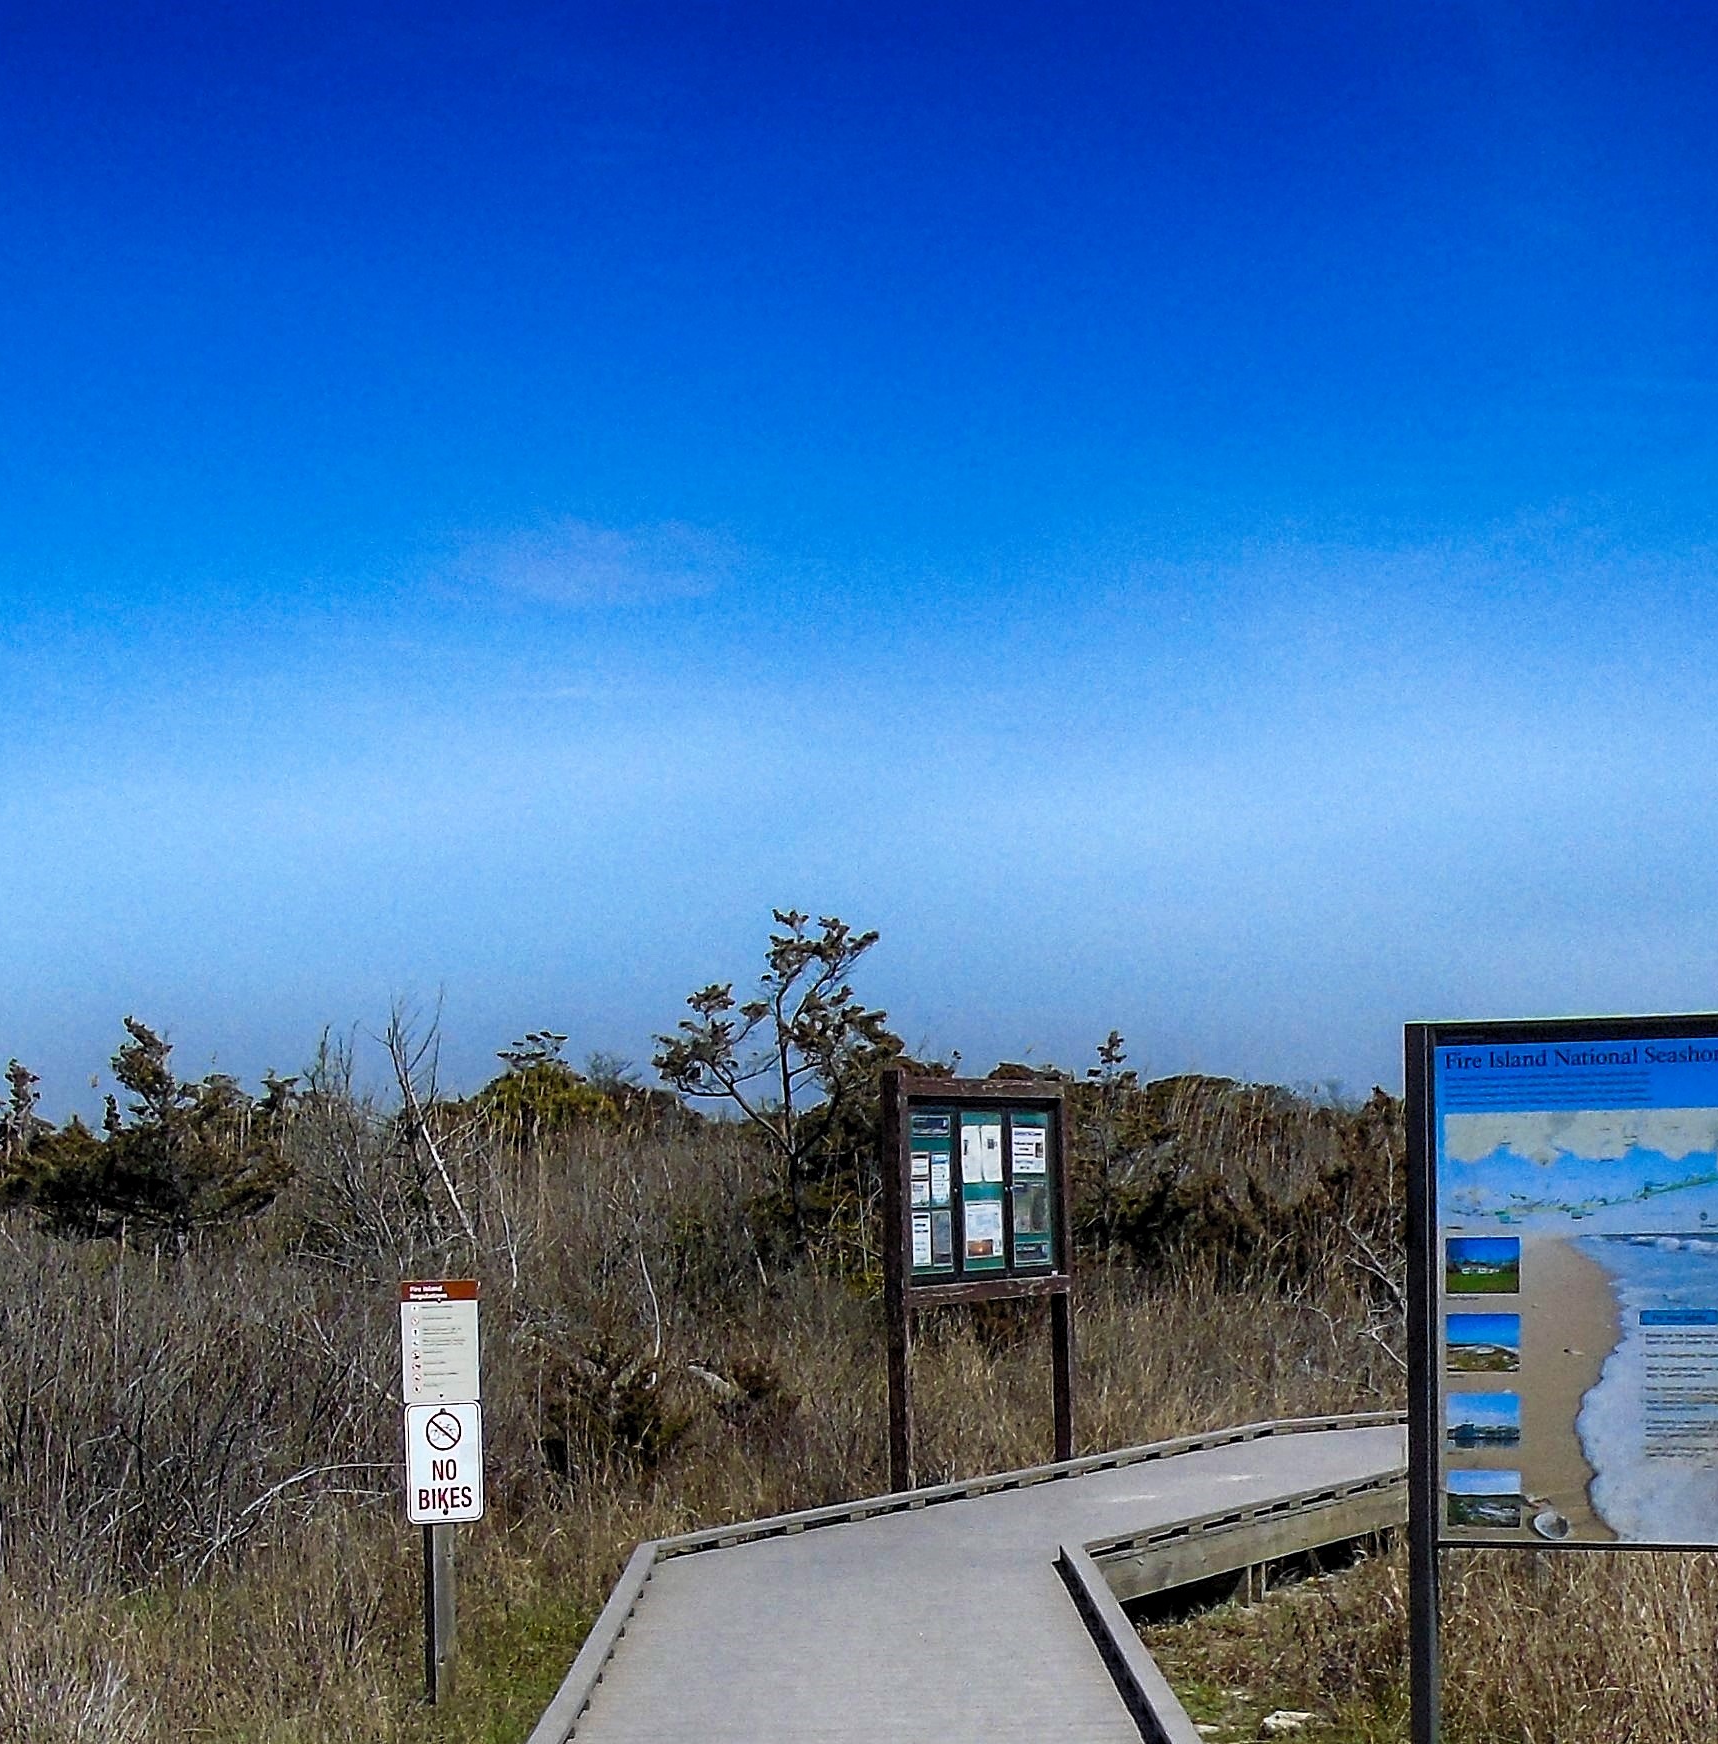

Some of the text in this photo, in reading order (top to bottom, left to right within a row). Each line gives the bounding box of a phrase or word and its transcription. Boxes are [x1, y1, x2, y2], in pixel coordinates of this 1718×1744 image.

[1444, 1051, 1482, 1069] Fire
[1489, 1050, 1547, 1068] Island
[1554, 1047, 1638, 1067] National
[432, 1459, 457, 1481] NO
[419, 1486, 472, 1510] BIKES
